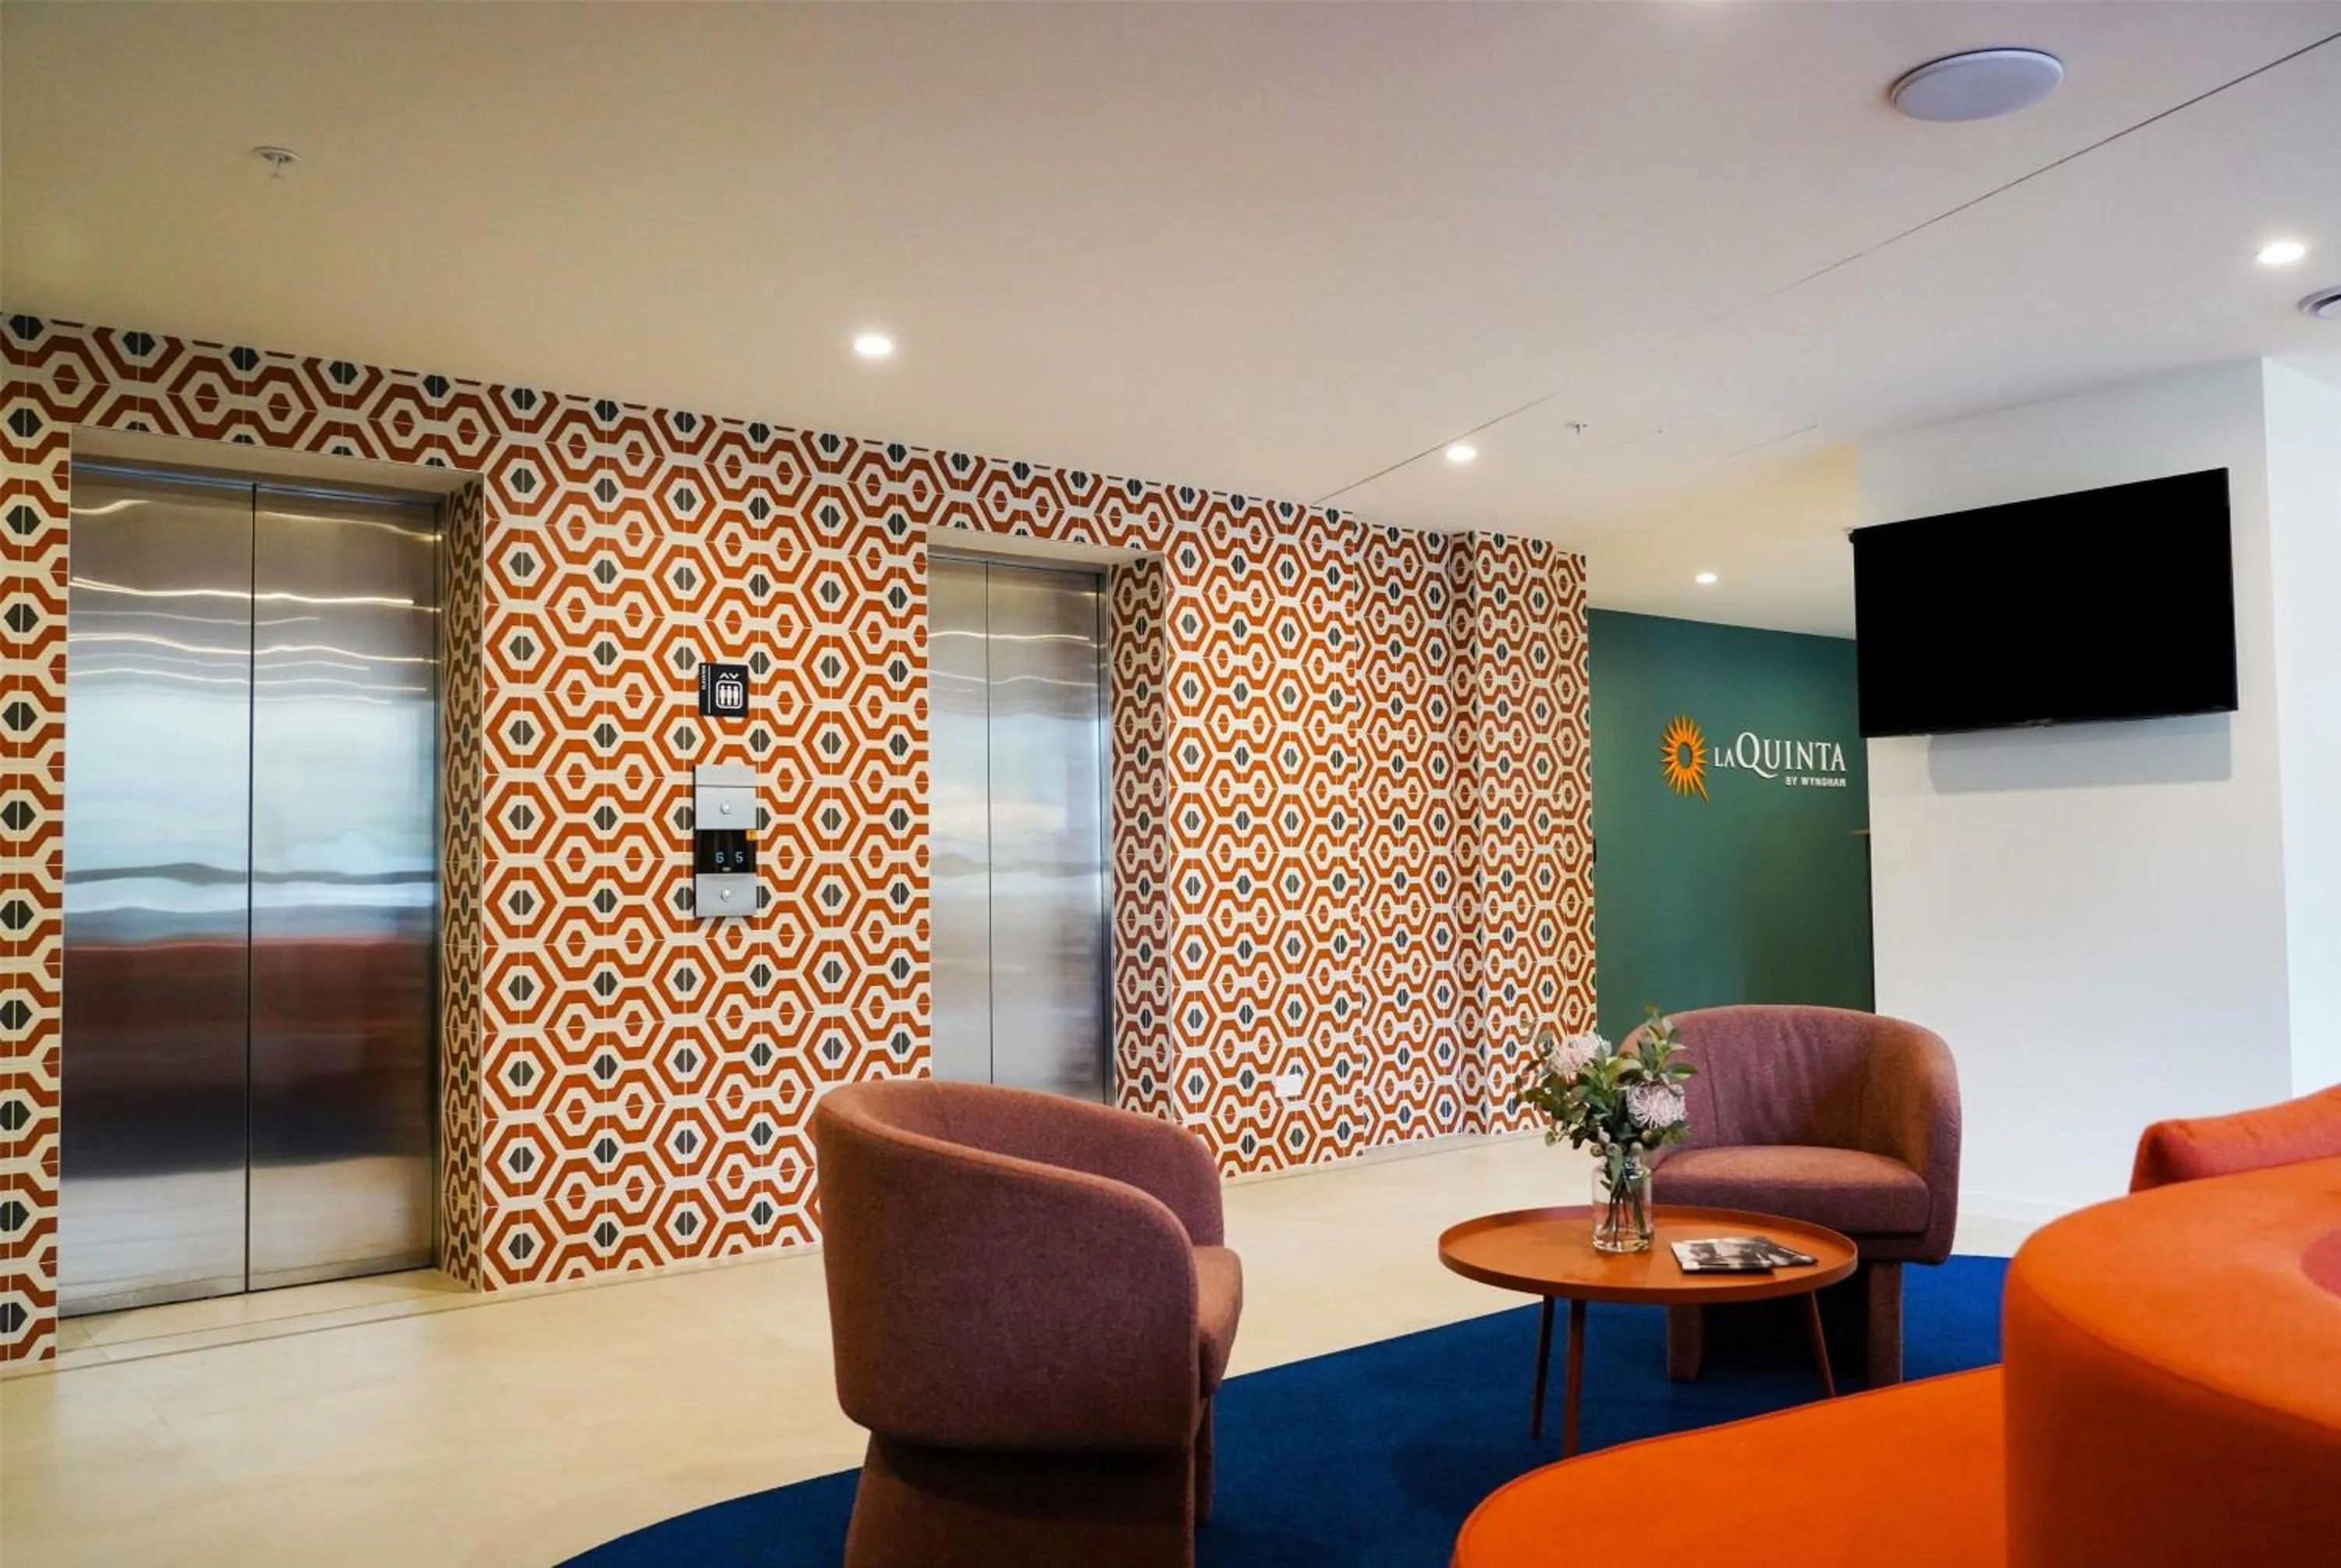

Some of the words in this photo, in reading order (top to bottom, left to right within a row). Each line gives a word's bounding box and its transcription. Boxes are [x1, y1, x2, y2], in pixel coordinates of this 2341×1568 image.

[1714, 747, 1735, 768] LA
[1735, 732, 1846, 778] QUINTA
[1785, 776, 1798, 786] BY
[1800, 777, 1846, 787] WYNDHAM
